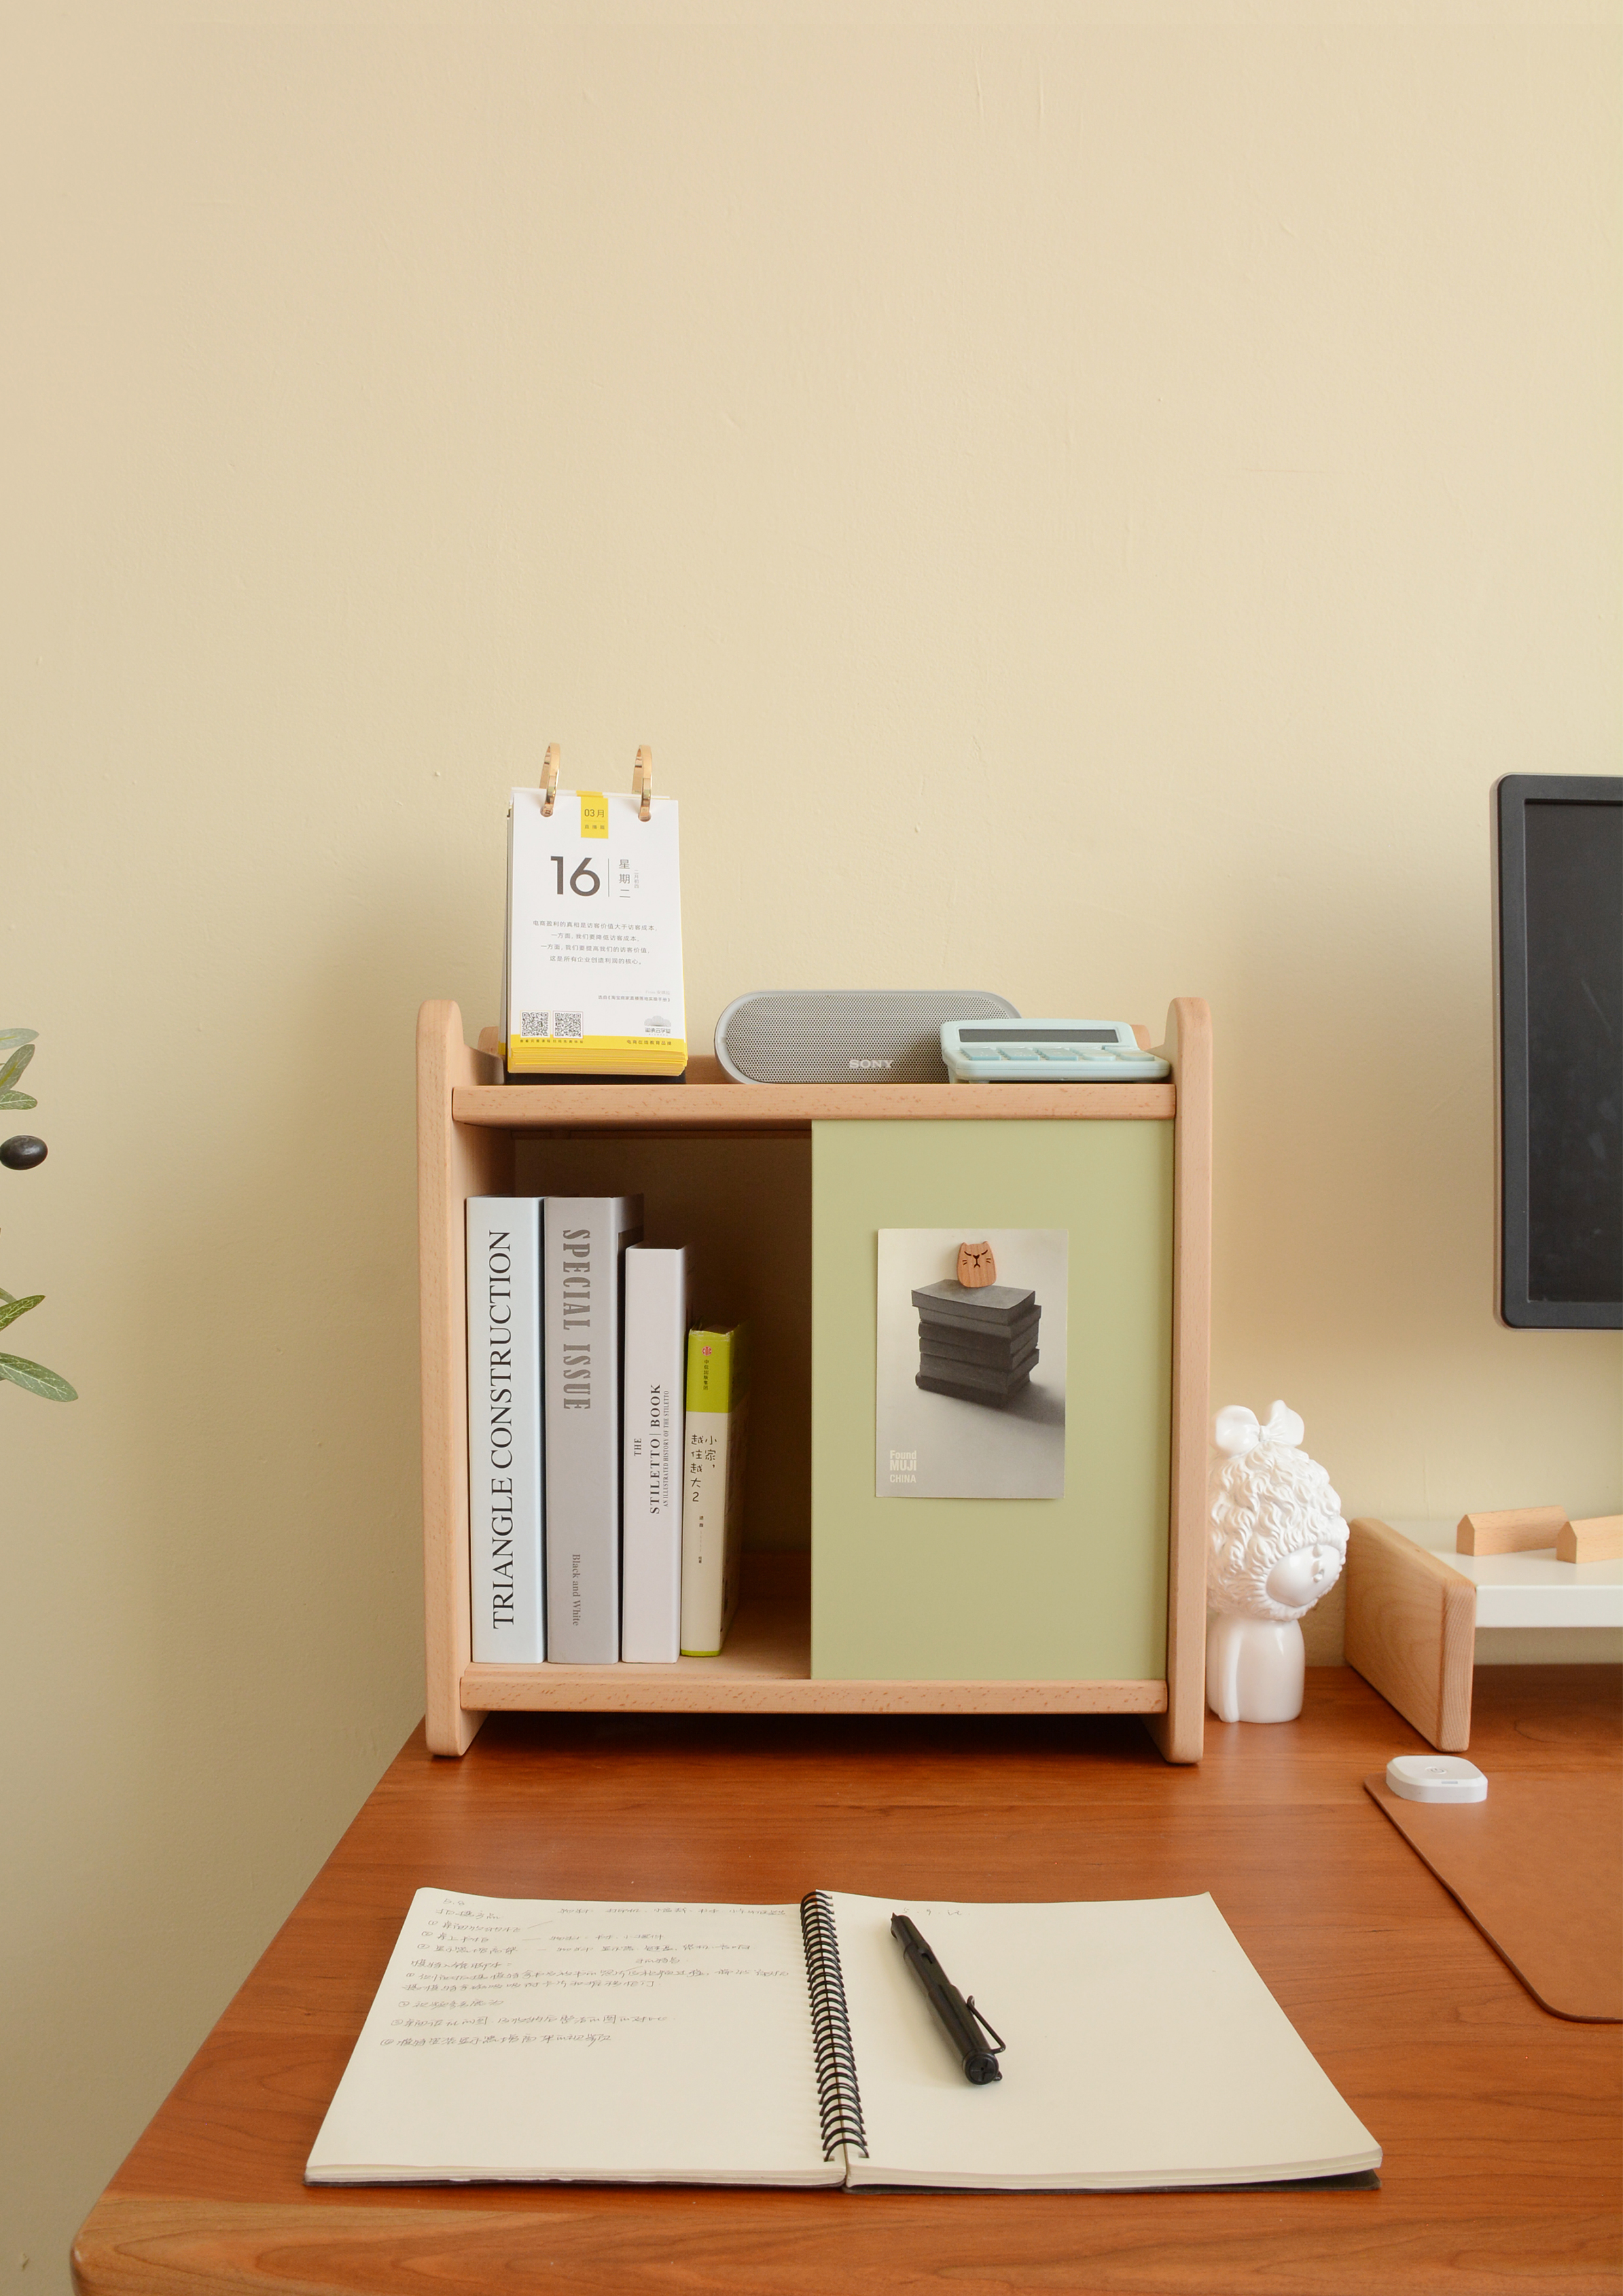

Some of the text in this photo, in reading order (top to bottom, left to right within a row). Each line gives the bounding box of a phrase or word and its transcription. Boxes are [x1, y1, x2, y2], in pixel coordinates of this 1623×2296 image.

[584, 809, 605, 818] 03月
[550, 855, 601, 897] 16
[618, 859, 631, 899] 星期二
[849, 1058, 895, 1068] SONY
[563, 1229, 591, 1410] SPECIAL ISSUE
[489, 1230, 515, 1630] TRIANGLE CONSTRUCTION
[633, 1438, 642, 1456] THE
[649, 1384, 661, 1515] STILETTO BOOK
[690, 1433, 704, 1503] 越住越大2
[890, 1450, 917, 1460] Found
[890, 1460, 917, 1471] MUJI
[889, 1474, 917, 1483] CHINA
[572, 1554, 581, 1626] Black and White
